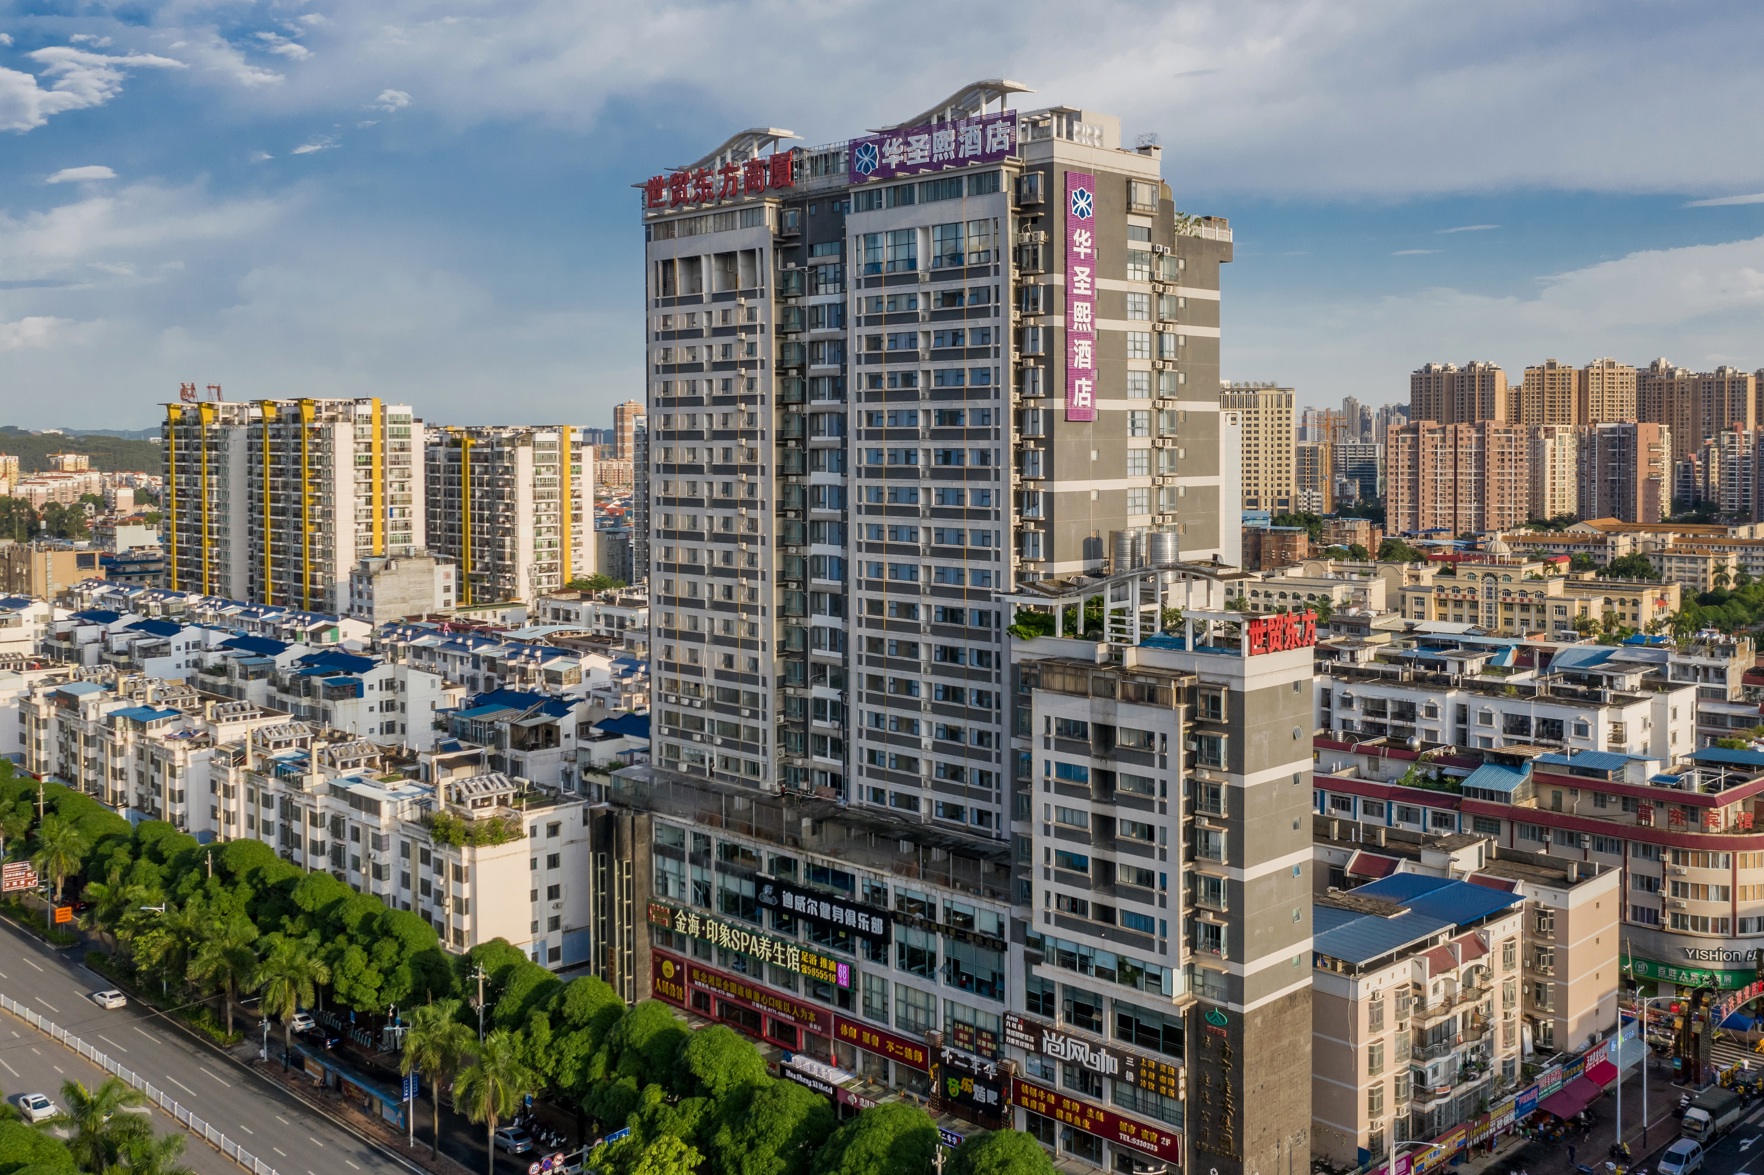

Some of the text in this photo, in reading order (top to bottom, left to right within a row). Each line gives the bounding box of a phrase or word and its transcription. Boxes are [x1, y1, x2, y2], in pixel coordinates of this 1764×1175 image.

[882, 119, 1011, 169] 华圣熙酒店
[645, 150, 794, 208] 世贸东方商厦
[1072, 228, 1093, 409] 华圣熙酒店
[1248, 608, 1318, 656] 世贸东方
[782, 890, 884, 935] 迪威尔健身俱乐部
[655, 978, 684, 1001] 人民公社
[838, 964, 847, 980] 68
[1160, 1136, 1171, 1147] 2F
